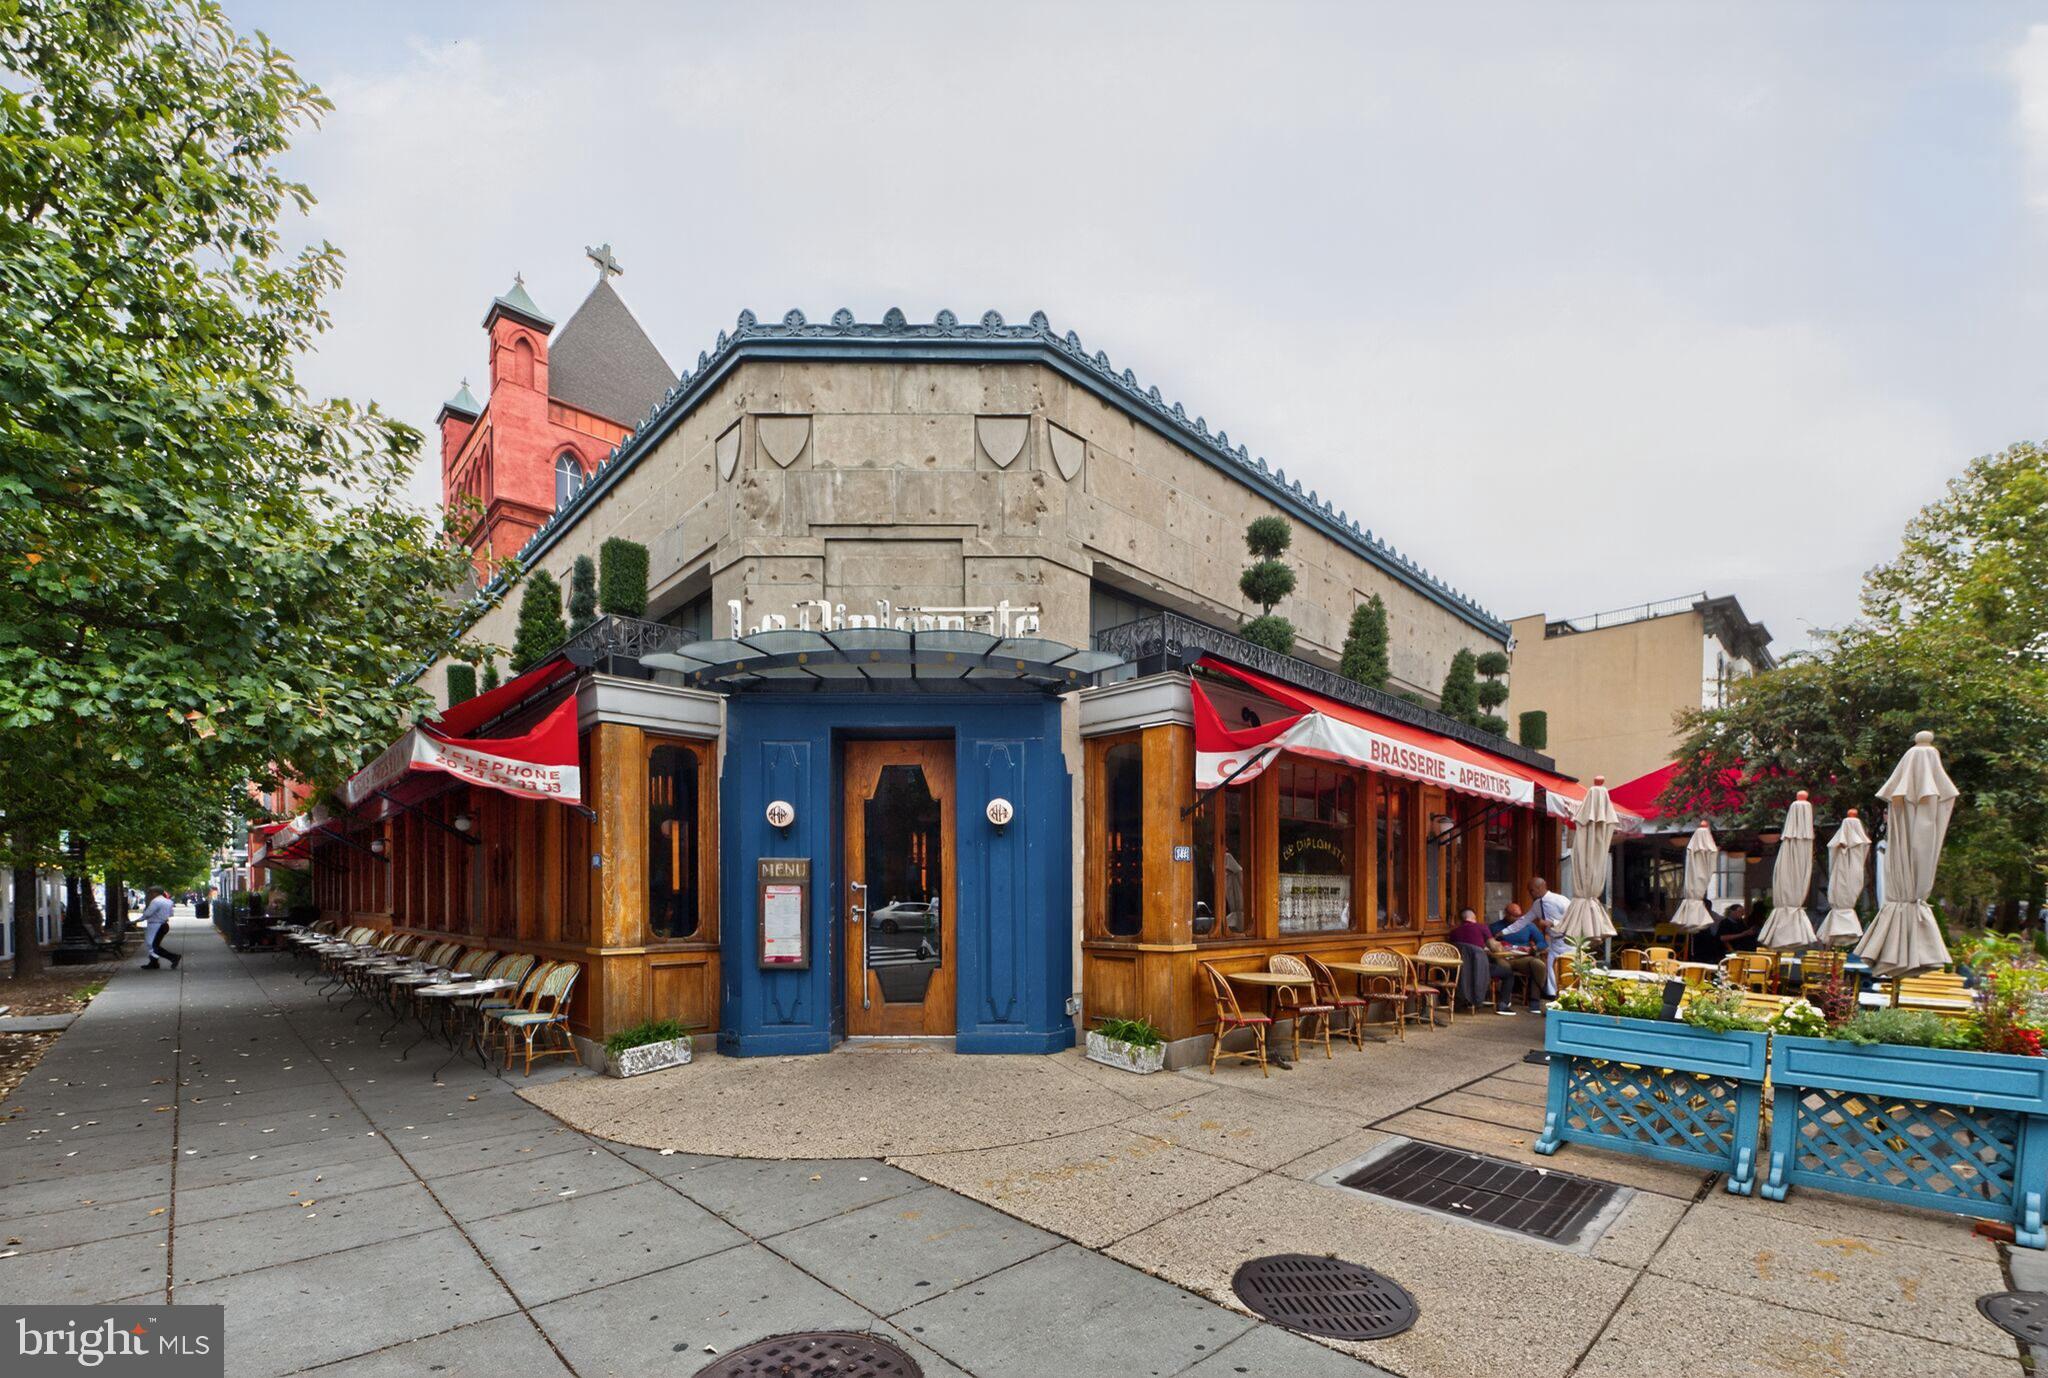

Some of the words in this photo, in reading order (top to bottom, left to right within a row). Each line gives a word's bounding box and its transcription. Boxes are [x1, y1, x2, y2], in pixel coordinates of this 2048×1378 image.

[440, 745, 560, 780] TELEPHONE
[1371, 739, 1446, 780] BRASSERIE
[1459, 767, 1511, 796] APERITIFS
[761, 863, 806, 878] MENU
